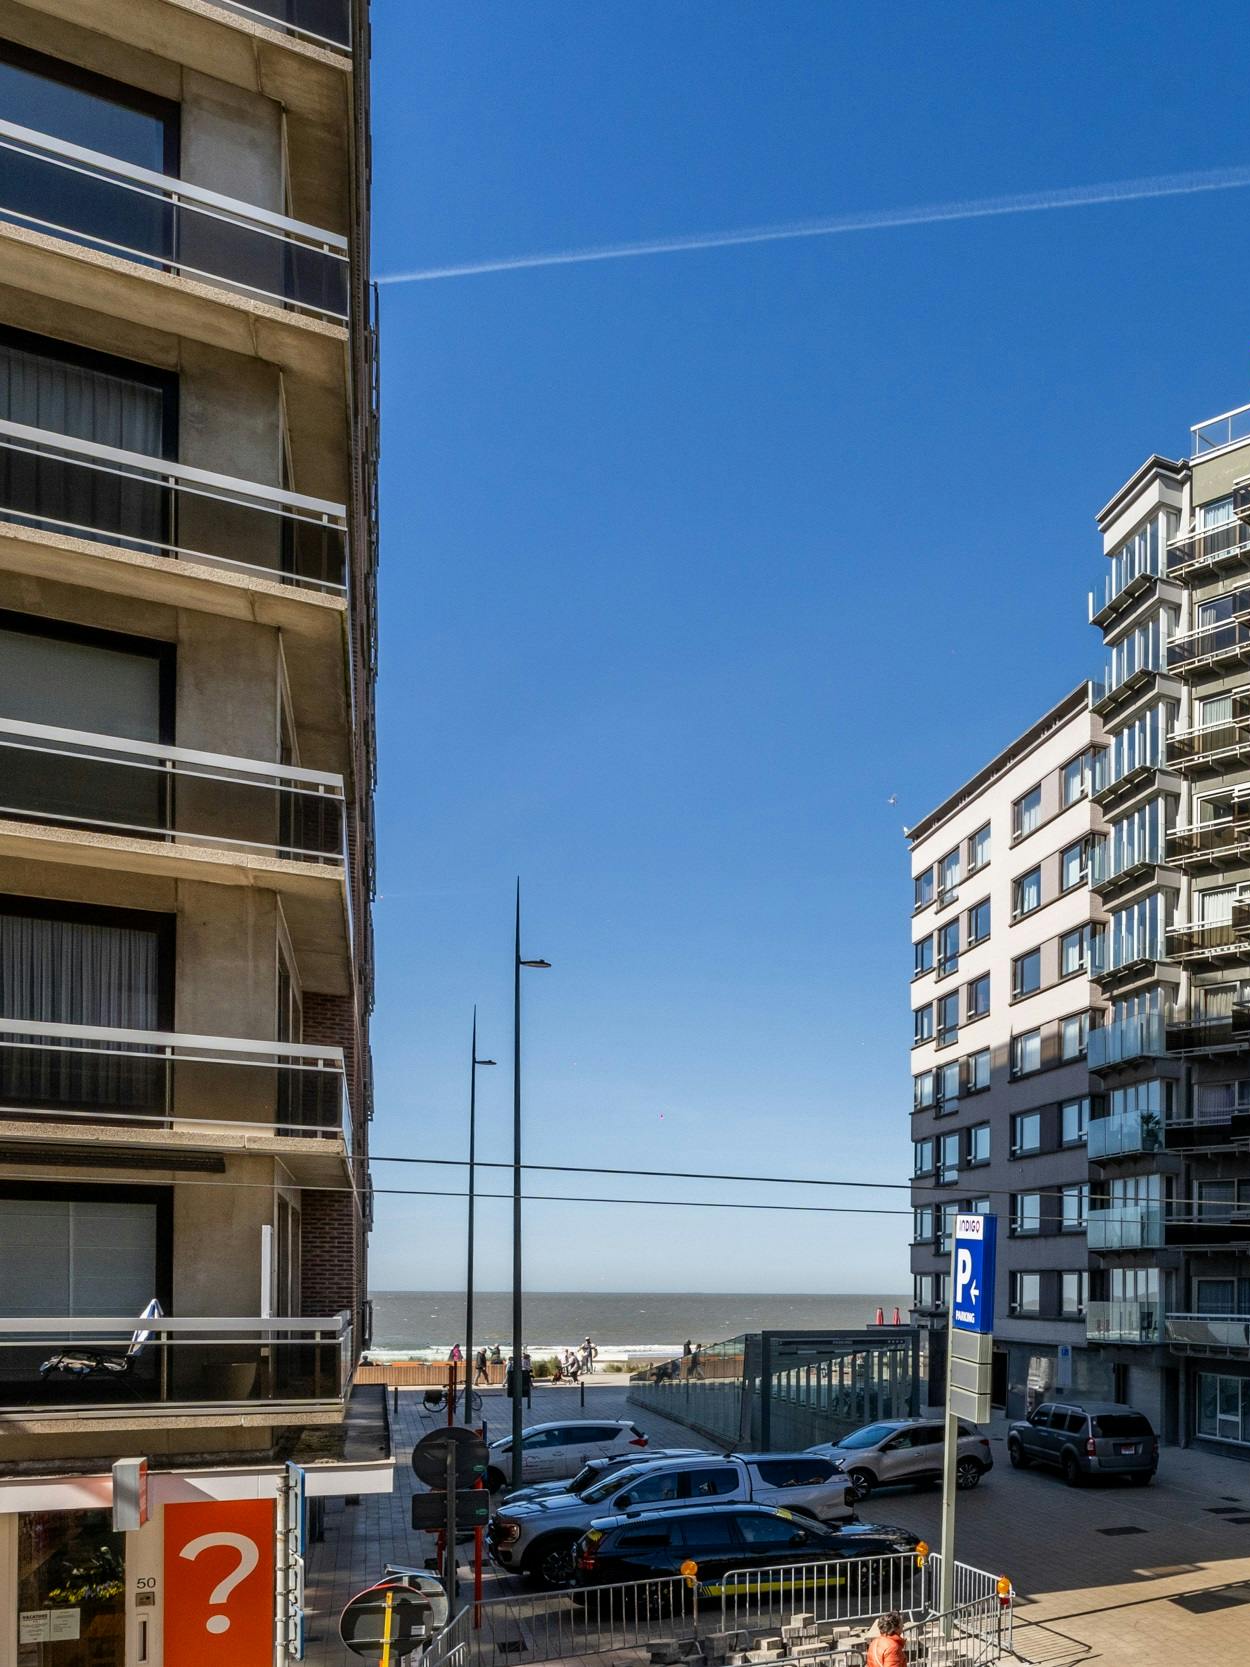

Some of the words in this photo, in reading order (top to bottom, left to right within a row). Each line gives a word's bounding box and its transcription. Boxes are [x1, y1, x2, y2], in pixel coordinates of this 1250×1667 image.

[960, 1220, 981, 1233] INDIGO
[956, 1248, 972, 1303] P
[955, 1309, 976, 1324] PARKING
[136, 1577, 156, 1589] 50
